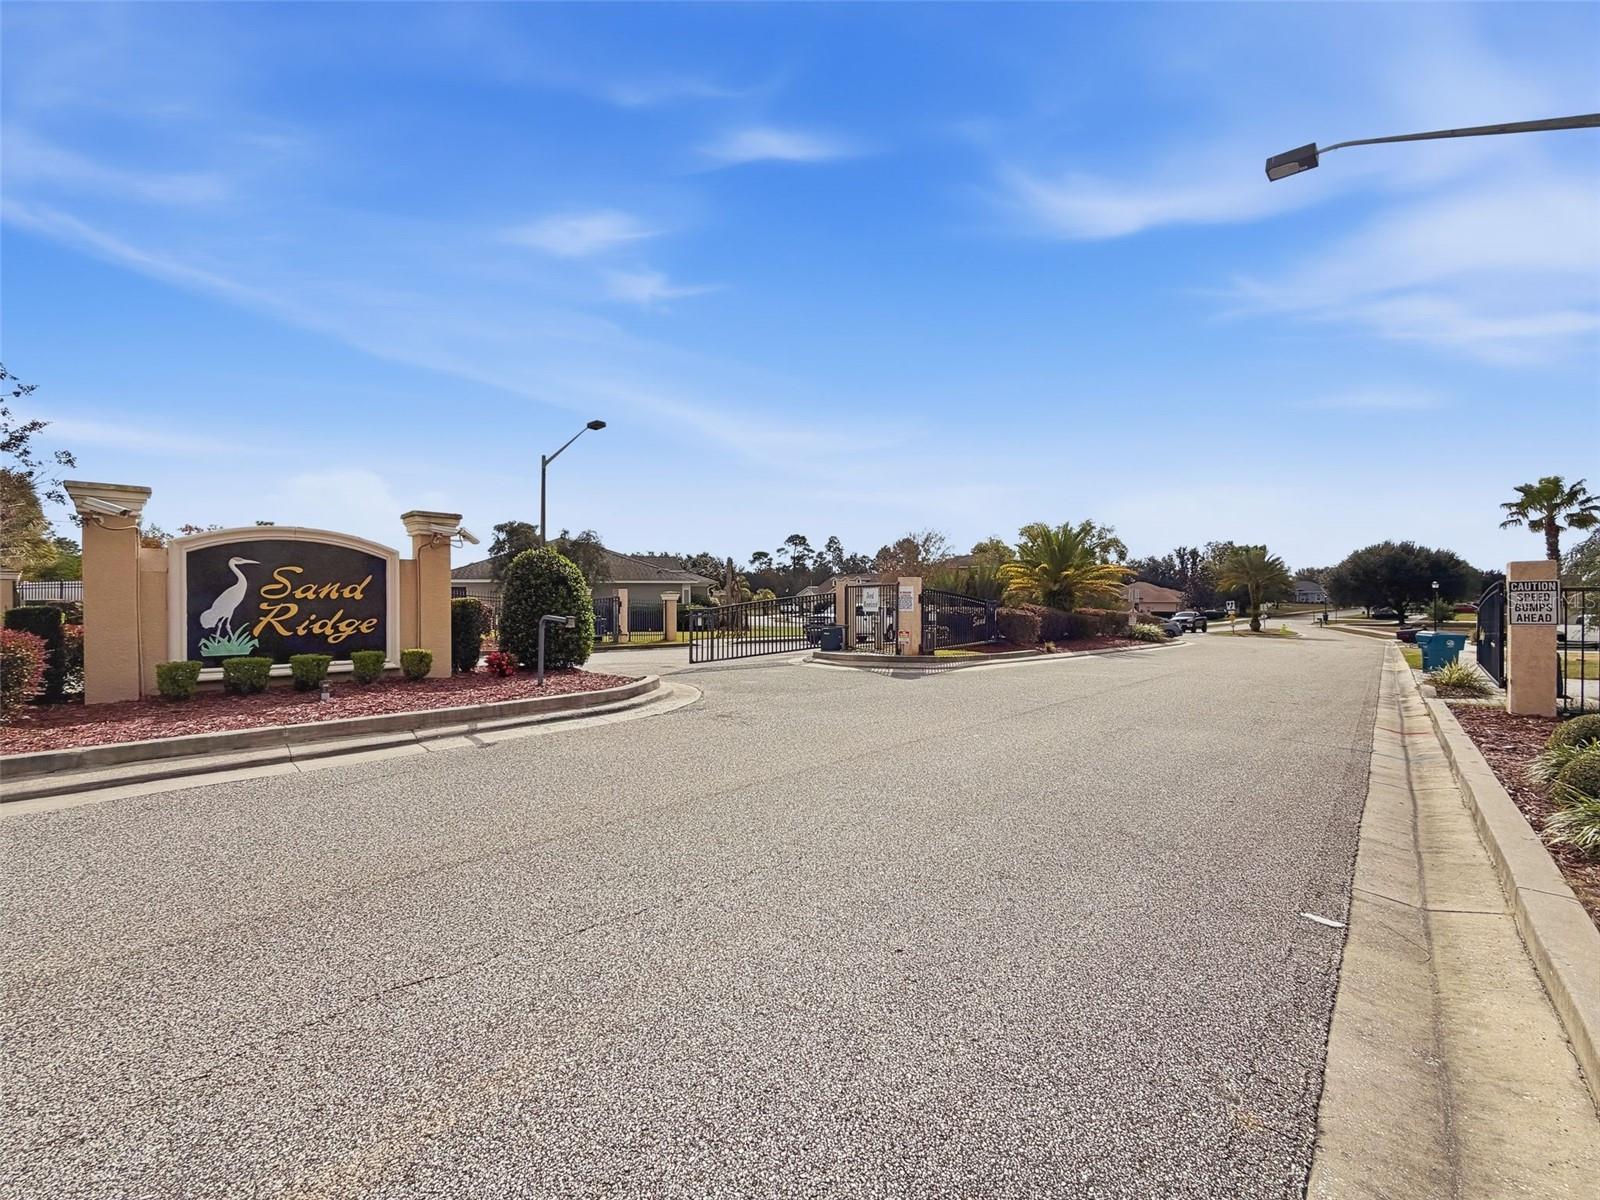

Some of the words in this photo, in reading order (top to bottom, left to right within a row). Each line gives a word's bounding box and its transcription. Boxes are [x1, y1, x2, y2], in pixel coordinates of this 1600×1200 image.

[260, 566, 373, 600] Sand
[1511, 582, 1556, 591] CAUTION
[1517, 593, 1550, 602] SPEED
[1515, 603, 1553, 612] BUMPS
[1516, 613, 1552, 623] AHEAD
[252, 602, 378, 644] Ridge
